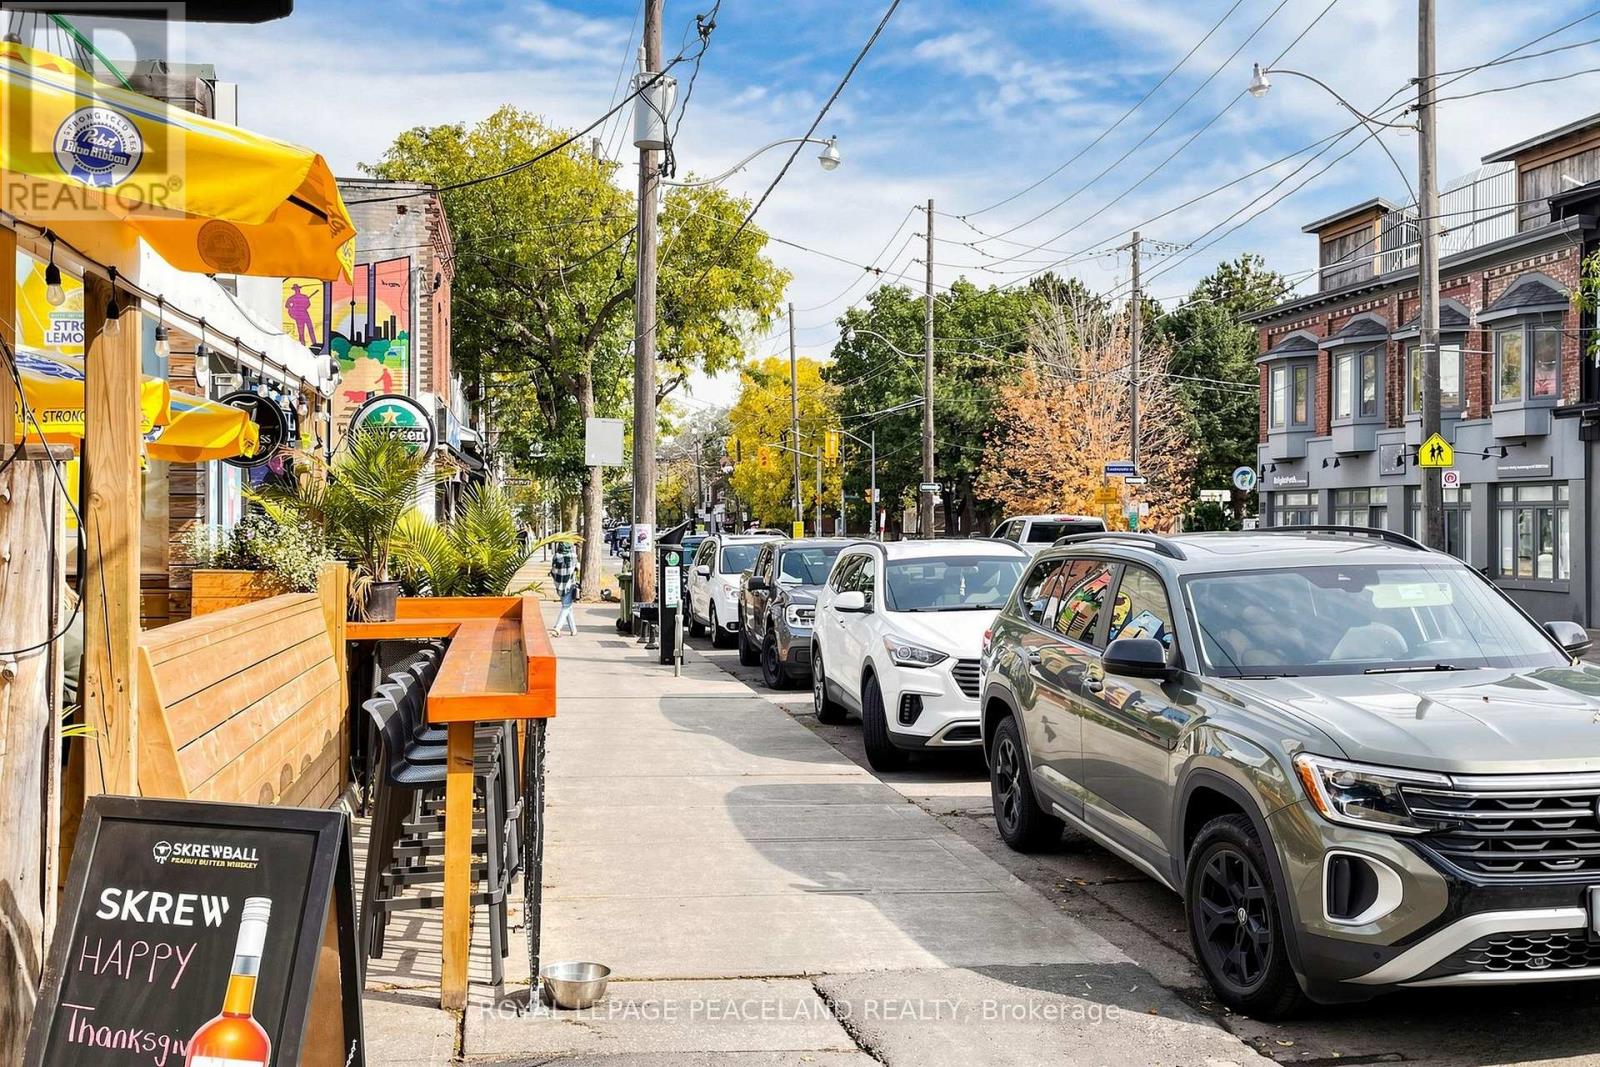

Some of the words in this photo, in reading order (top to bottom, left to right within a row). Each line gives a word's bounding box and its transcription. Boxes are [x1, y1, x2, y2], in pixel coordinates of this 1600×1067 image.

[63, 112, 101, 136] STRONG
[105, 114, 129, 132] ICED
[82, 128, 119, 149] Pabst
[66, 139, 90, 156] Blue
[89, 146, 128, 166] Ribbon
[171, 857, 198, 865] PEANUT
[172, 843, 259, 861] SKREWBALL
[96, 888, 230, 928] SKREW
[78, 935, 198, 990] HAPPY
